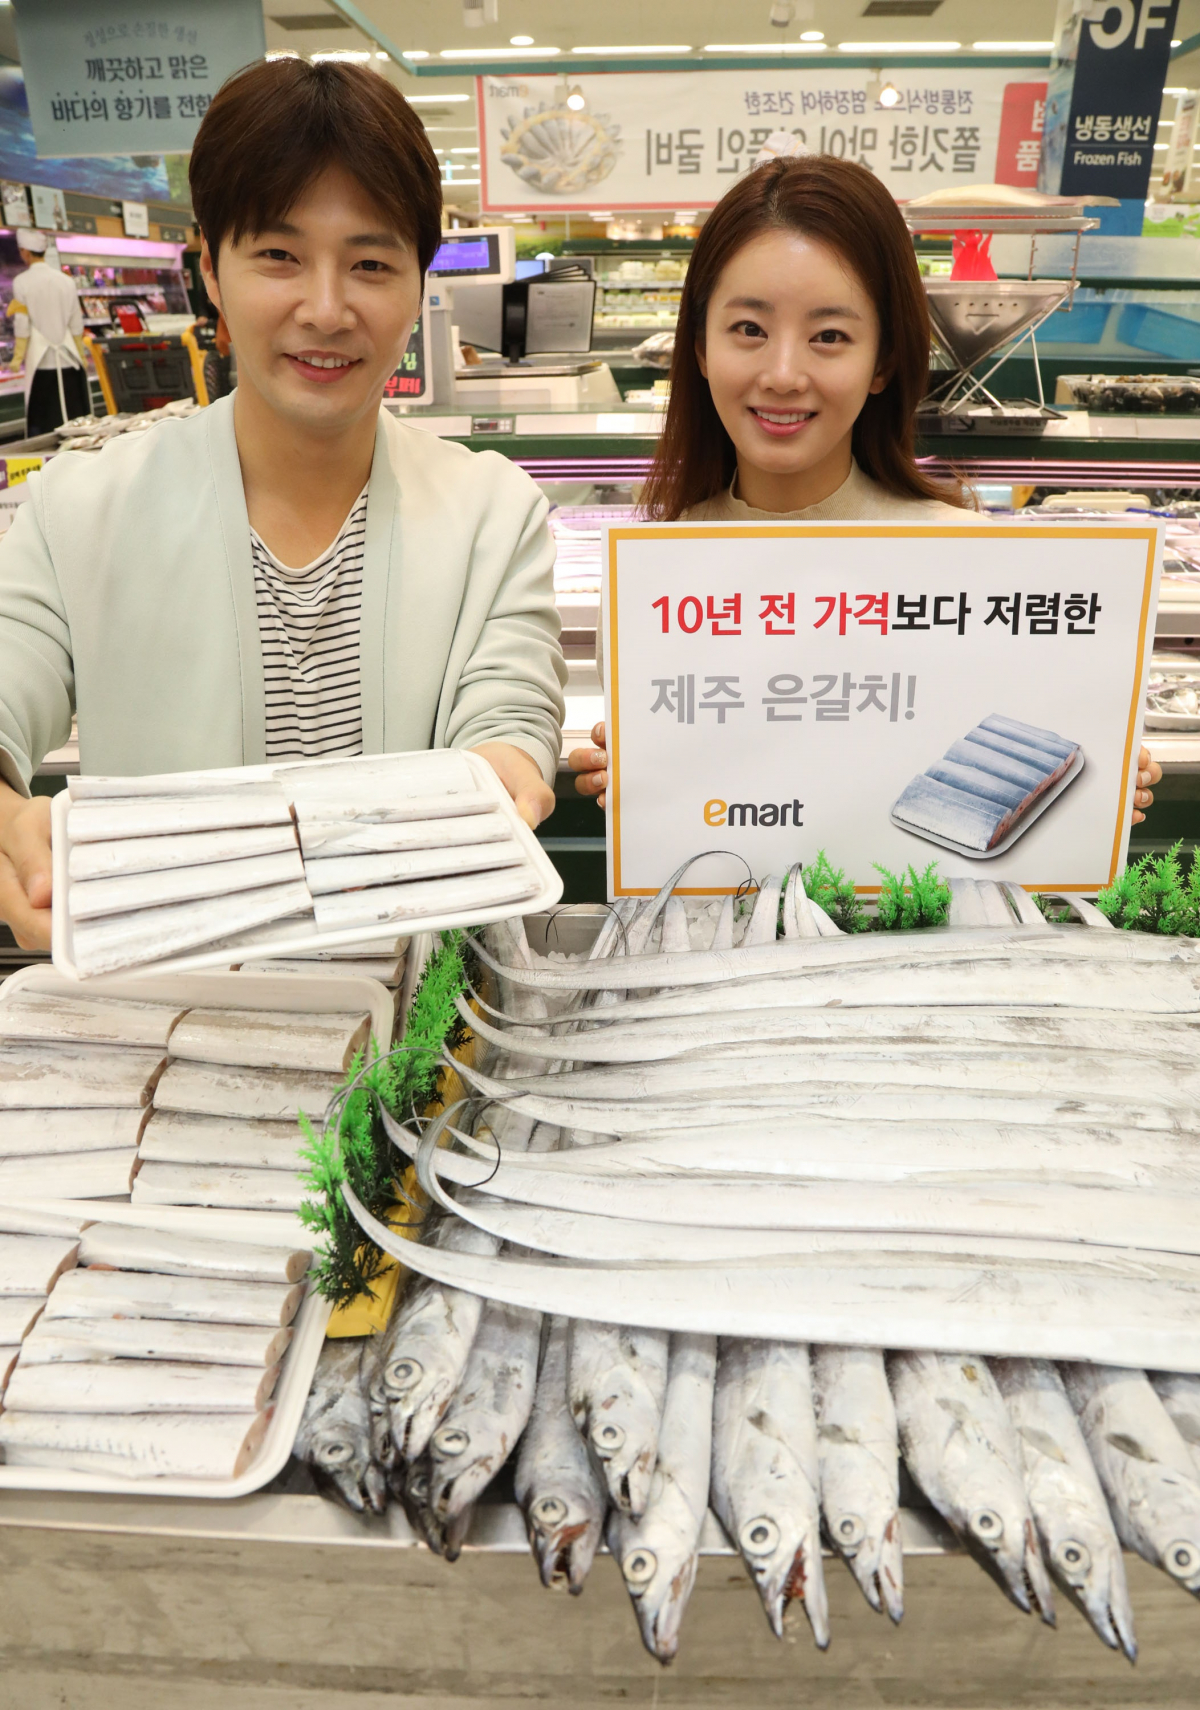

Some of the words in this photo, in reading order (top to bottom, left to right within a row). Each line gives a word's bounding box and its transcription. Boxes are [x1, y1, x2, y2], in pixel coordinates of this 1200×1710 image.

[85, 56, 164, 82] 깨끗하고
[168, 54, 208, 79] 맑은
[51, 97, 109, 122] 바다의
[115, 95, 172, 120] 향기를
[1075, 115, 1152, 141] 냉동생선
[1074, 151, 1115, 165] Frozen
[1117, 151, 1142, 165] Fish
[651, 593, 742, 636] 10년
[758, 592, 796, 635] 전
[812, 592, 972, 636] 가격보다
[983, 592, 1102, 635] 저렴한
[649, 673, 745, 724] 제주
[761, 672, 917, 722] 은갈치!
[703, 798, 804, 827] emart
